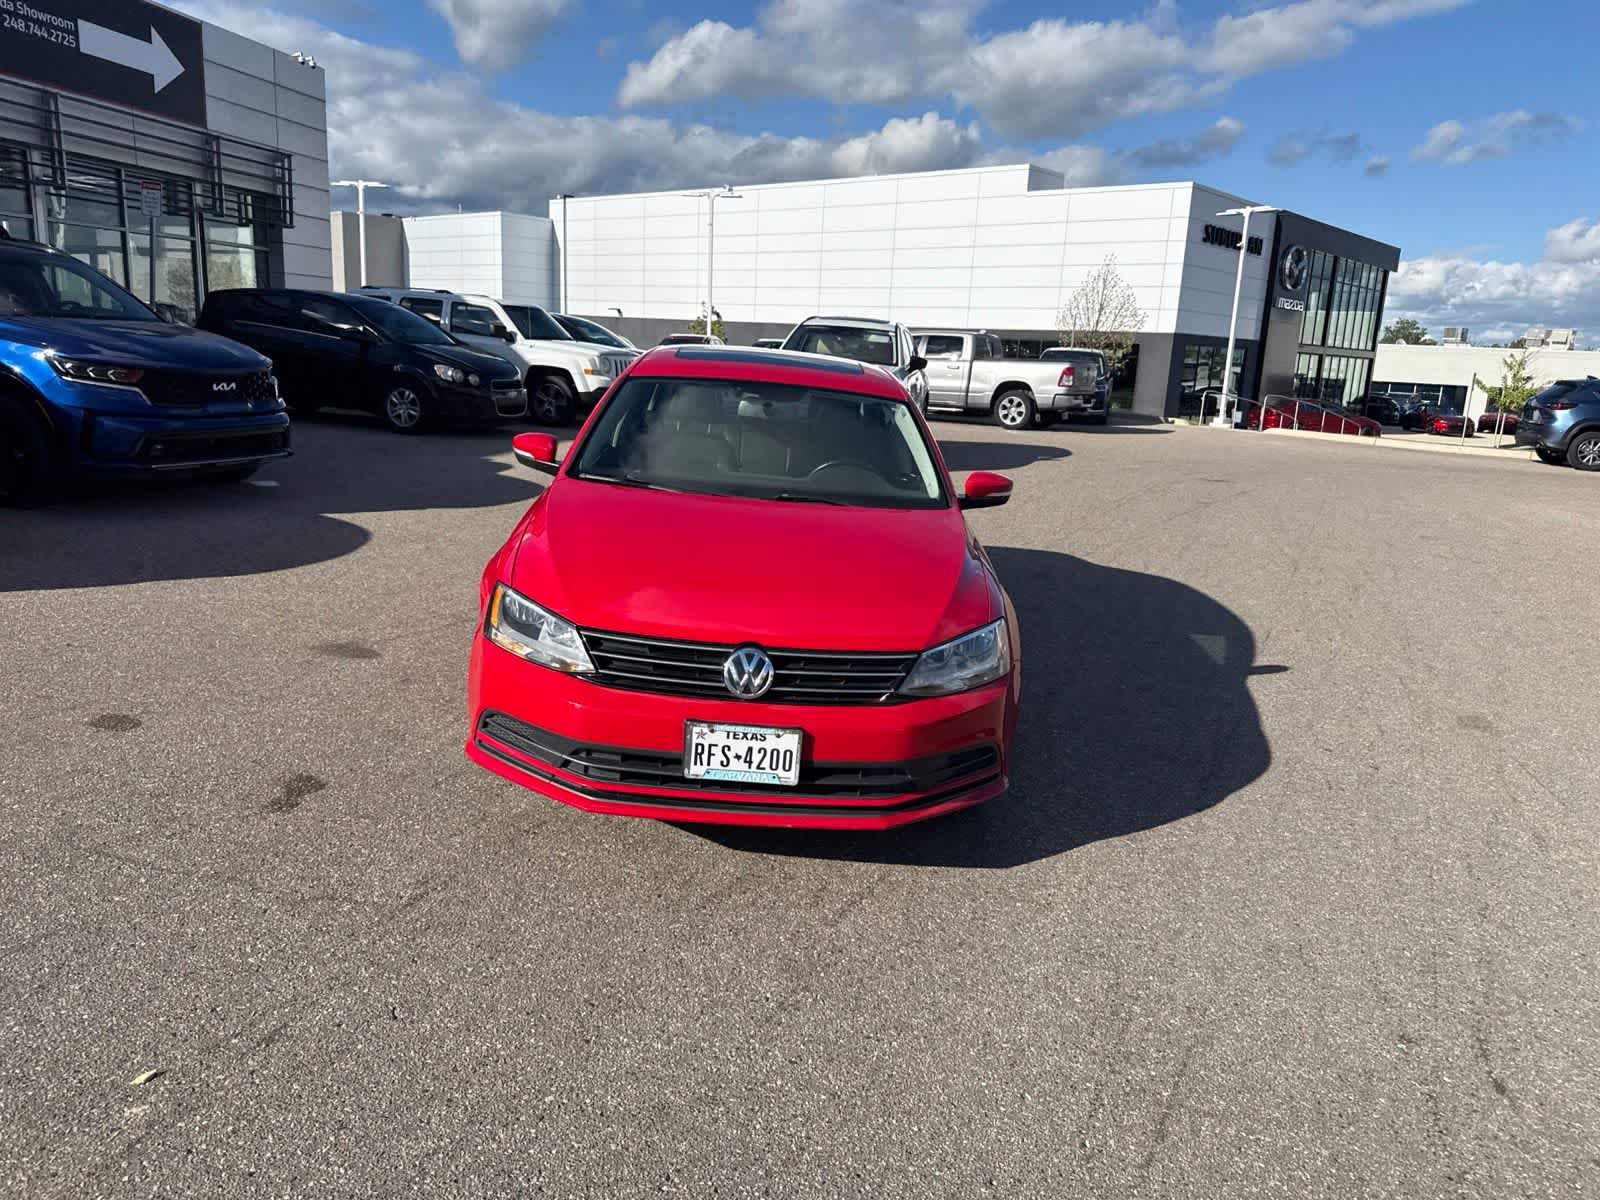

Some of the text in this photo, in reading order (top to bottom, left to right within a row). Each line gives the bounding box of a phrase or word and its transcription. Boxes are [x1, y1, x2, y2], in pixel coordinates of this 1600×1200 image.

[2, 14, 76, 48] 248.744.2725
[15, 1, 75, 31] Showroom
[725, 730, 767, 742] TEXAS
